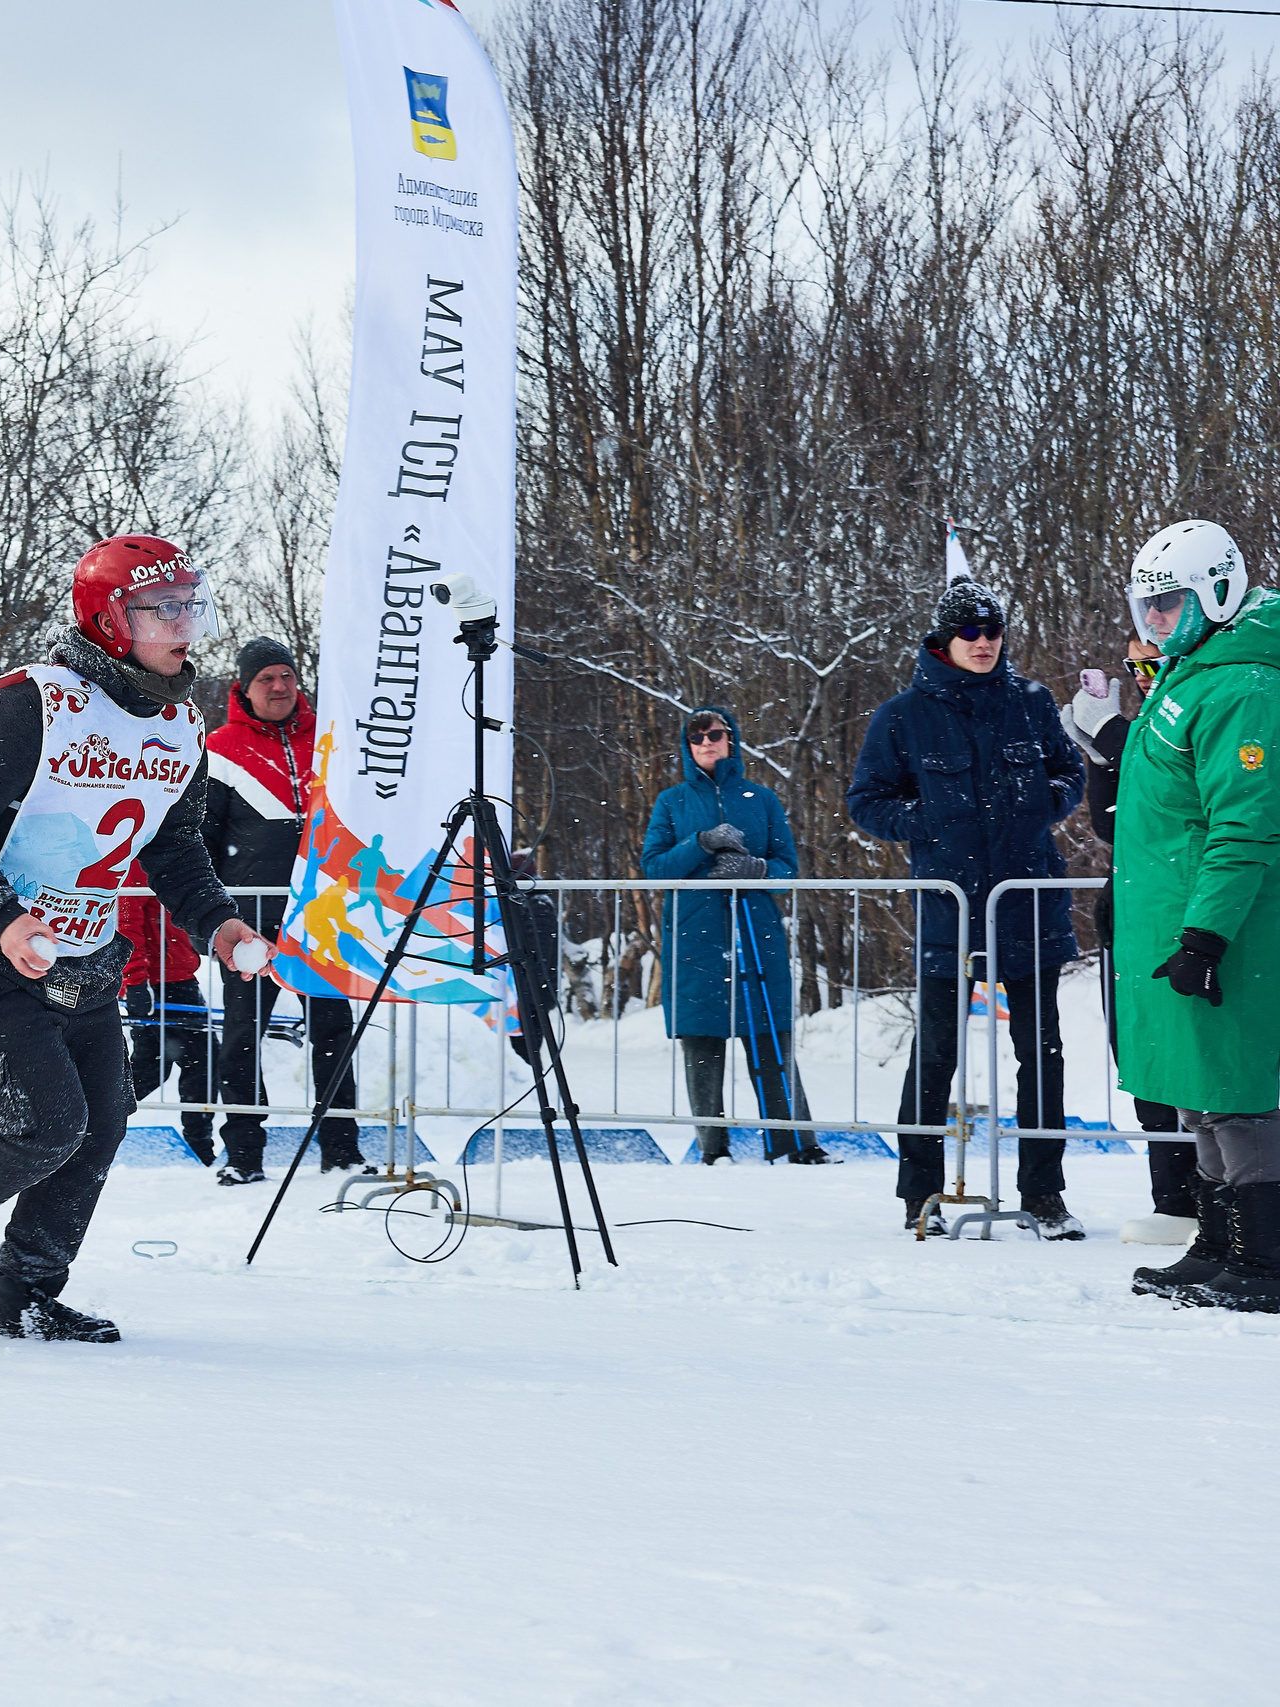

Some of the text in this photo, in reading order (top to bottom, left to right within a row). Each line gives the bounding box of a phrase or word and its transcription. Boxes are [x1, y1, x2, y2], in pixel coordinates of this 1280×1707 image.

[356, 273, 465, 801] МАУ ГСЦ «Авангард»
[48, 775, 72, 788] RUSSIA,
[76, 798, 145, 890] 2
[38, 892, 63, 904] ДЛЯ
[34, 900, 78, 914] КТО ЗНАЕТ
